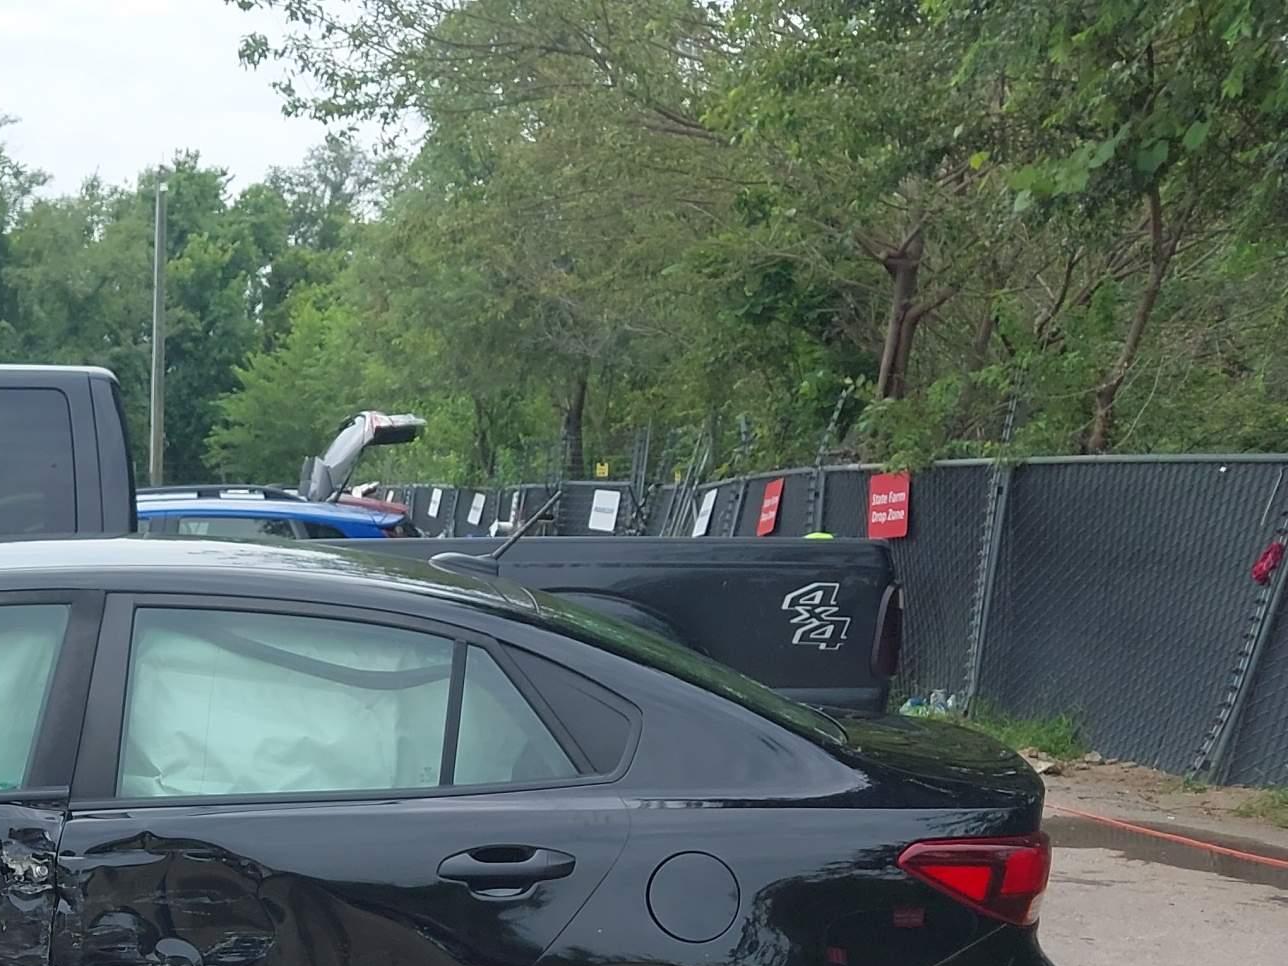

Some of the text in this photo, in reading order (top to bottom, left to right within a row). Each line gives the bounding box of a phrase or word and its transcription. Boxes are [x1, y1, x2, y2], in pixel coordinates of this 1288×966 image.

[872, 490, 906, 506] State Farm
[872, 508, 905, 525] Drop Zone
